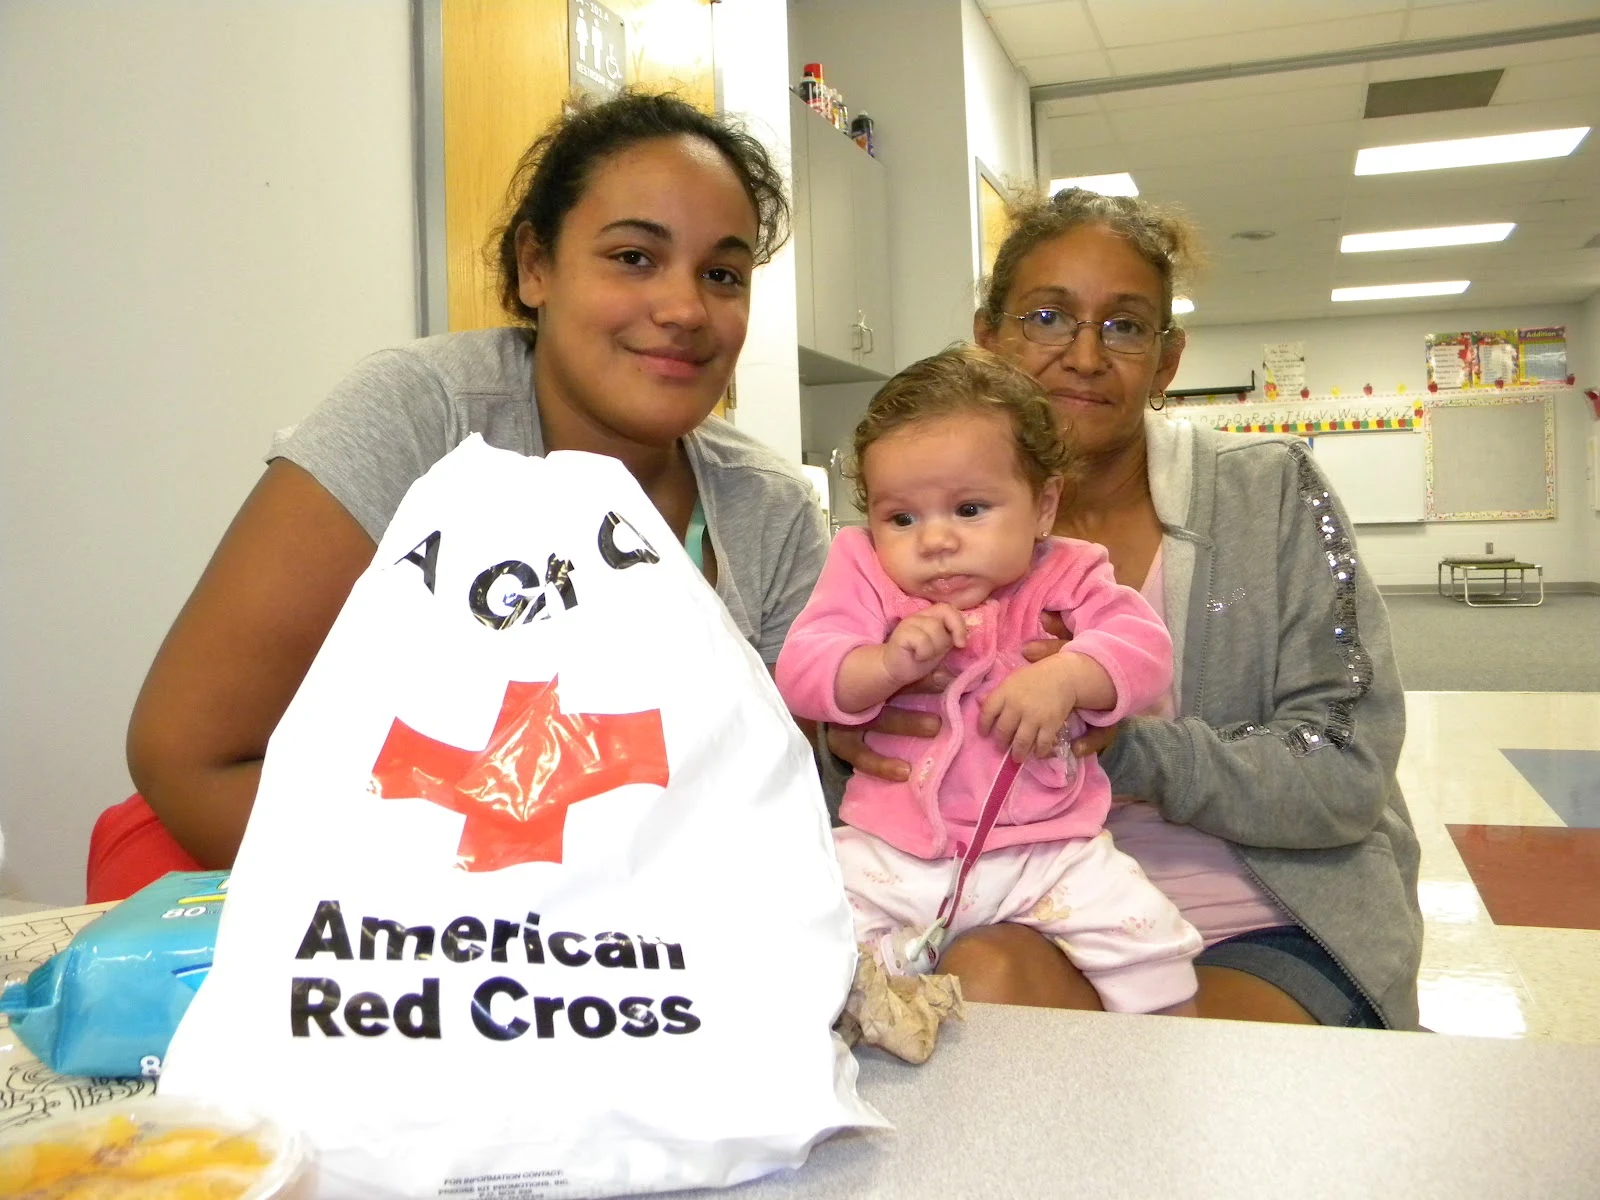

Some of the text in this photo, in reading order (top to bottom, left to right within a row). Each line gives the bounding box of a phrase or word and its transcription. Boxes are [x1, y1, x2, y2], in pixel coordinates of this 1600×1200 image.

[1526, 330, 1557, 339] Addition
[161, 906, 206, 919] 80
[295, 900, 686, 970] American
[291, 976, 702, 1042] Red Cross
[443, 1177, 462, 1186] FOR
[464, 1172, 521, 1185] INFORMATION
